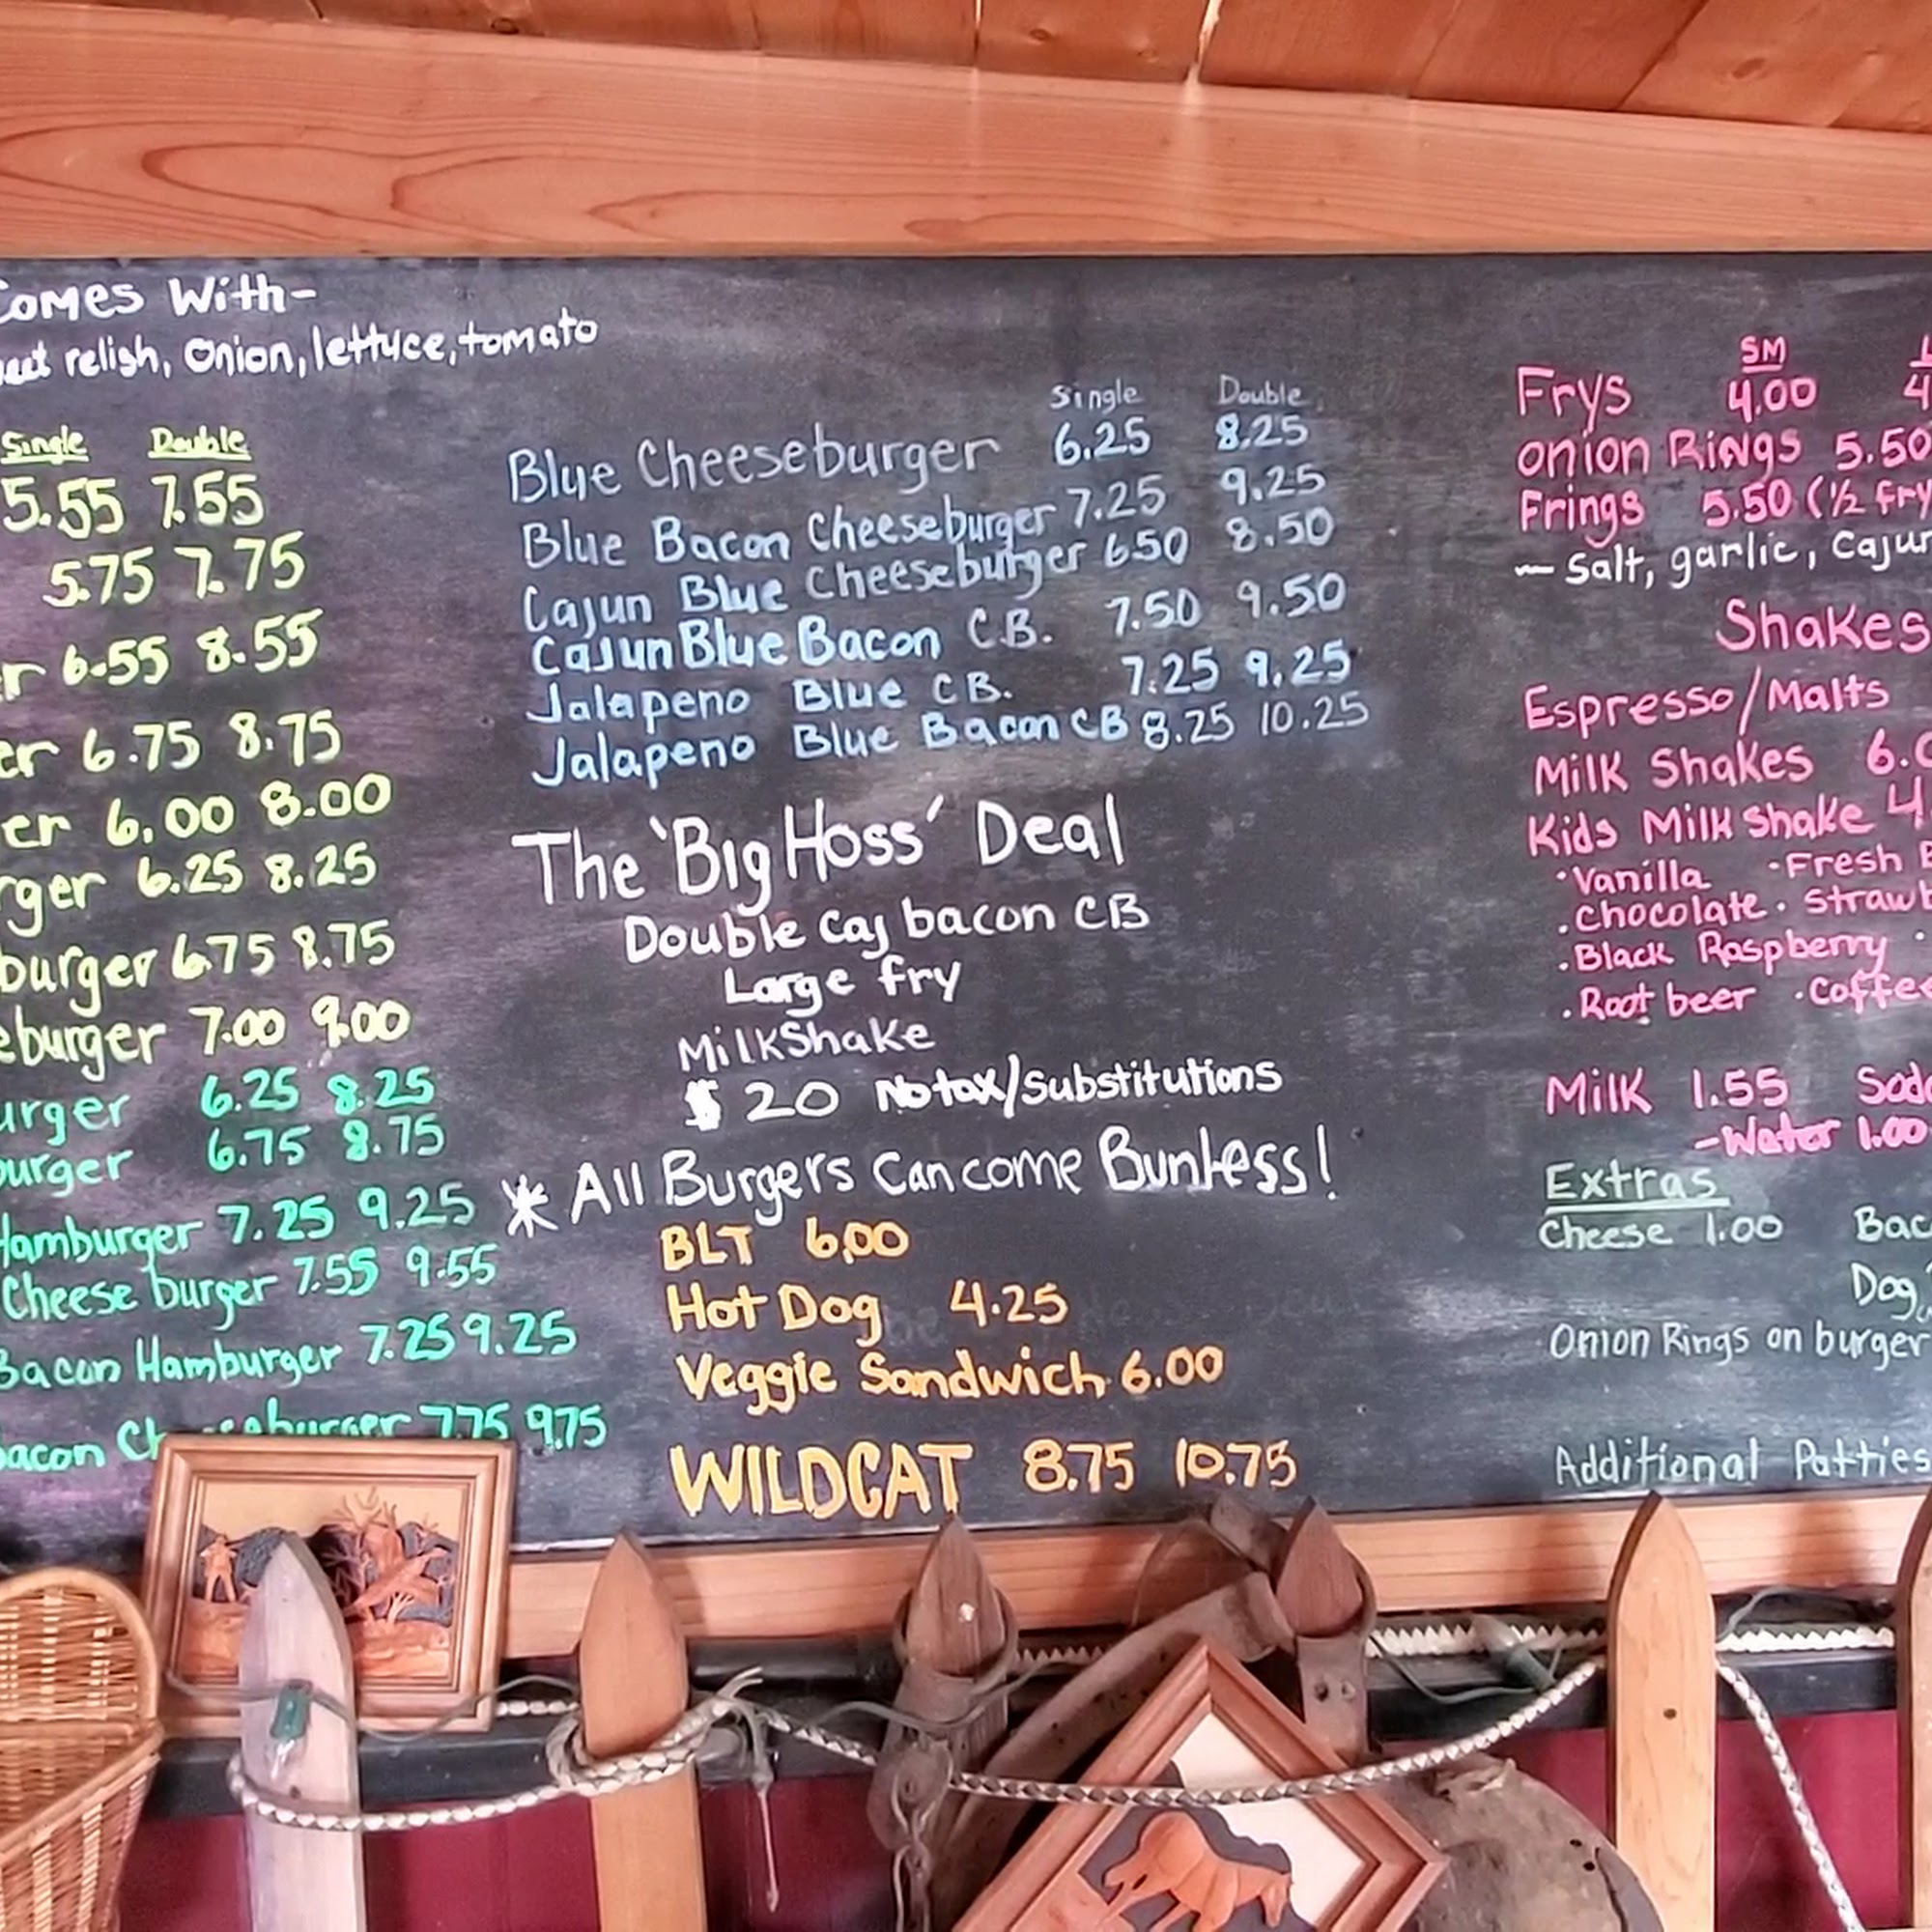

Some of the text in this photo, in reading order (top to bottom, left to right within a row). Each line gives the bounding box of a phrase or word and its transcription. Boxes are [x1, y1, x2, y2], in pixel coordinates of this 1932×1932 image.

[458, 307, 598, 357] tomato
[1741, 335, 1785, 363] SM
[1051, 374, 1302, 413] Single Double
[1517, 366, 1817, 433] Frys 4.00
[1, 425, 252, 465] Single Double
[508, 412, 1309, 503] Blue Cheeseburger 6.25 8.25
[1667, 429, 1802, 481] Rings
[1836, 427, 1932, 471] 5.50
[1, 470, 265, 539] 5.55 7.55
[523, 519, 626, 568] Blue
[651, 516, 789, 563] Bacon
[1066, 475, 1167, 528] 7.25
[1220, 464, 1326, 506] 9.25
[1521, 484, 1645, 549] Frings
[1701, 478, 1795, 528] 5.50
[43, 530, 305, 608] 5.75 7.75
[524, 586, 653, 639] Cajun
[680, 575, 788, 614] Blue
[1226, 506, 1334, 553] 8.50
[63, 636, 170, 686] 6.55
[196, 608, 324, 673] 8.55
[532, 635, 673, 678] Cajun
[678, 617, 789, 668] Blue
[797, 615, 941, 666] Bacon
[1104, 587, 1202, 638] 7.50
[1236, 572, 1347, 619] 9.50
[1715, 597, 1932, 654] Shakes
[526, 682, 751, 735] Jalapeno
[792, 678, 907, 713] Blue
[1122, 646, 1221, 696] 7.25
[1245, 639, 1351, 688] 9.25
[82, 721, 200, 771] 6.75
[230, 710, 341, 767] 8.75
[532, 730, 755, 788] Jalapeno
[792, 724, 899, 759] Blue
[922, 711, 1061, 750] Bacon
[1141, 701, 1236, 751] 8.25
[1261, 690, 1370, 736] 10.25
[1650, 739, 1813, 789] Shakes
[106, 797, 235, 847] 6.00
[260, 773, 392, 826] 8.00
[1528, 811, 1618, 858] Kids
[136, 841, 378, 897] 6.25 8.25
[512, 828, 645, 904] The
[977, 794, 1125, 867] Deal
[1572, 860, 1712, 895] Vanilla
[1786, 843, 1903, 878] Fresh
[292, 920, 395, 971] 8.75
[623, 913, 806, 963] Double
[901, 896, 1056, 940] bacon
[1074, 893, 1151, 929] CB
[1575, 929, 1888, 975] Black Raspberry
[724, 954, 962, 1018] Large fry
[1580, 980, 1757, 1021] Root beer
[188, 1007, 285, 1056] 7.00
[311, 994, 411, 1048] 9.00
[201, 1067, 299, 1120] 6.25
[327, 1066, 436, 1116] 8.25
[745, 1080, 839, 1122] 20
[1692, 1067, 1788, 1109] 1.55
[208, 1114, 444, 1173] 6.75 8.75
[1859, 1115, 1928, 1151] 1.00
[570, 1162, 644, 1223] All
[663, 1150, 853, 1227] Burgers
[1546, 1160, 1719, 1200] Extras
[216, 1195, 334, 1243] 7.25
[357, 1180, 475, 1230] 9.25
[1704, 1210, 1784, 1246] 1.00
[293, 1246, 381, 1295] 7.55
[407, 1242, 497, 1288] 9.55
[661, 1223, 753, 1271] BLT
[667, 1279, 1068, 1348] Hot Dog 4.25
[1851, 1262, 1918, 1321] Dog
[135, 1335, 343, 1388] Hamburger
[359, 1313, 457, 1365] 7.25
[462, 1308, 577, 1357] 9.25
[1549, 1320, 1931, 1371] Onion Rings on burger
[676, 1345, 1225, 1416] Veggie Sandwich 6.00
[669, 1437, 1298, 1520] WILDCAT 8.75 10.75
[1555, 1435, 1932, 1486] Additional Patties
